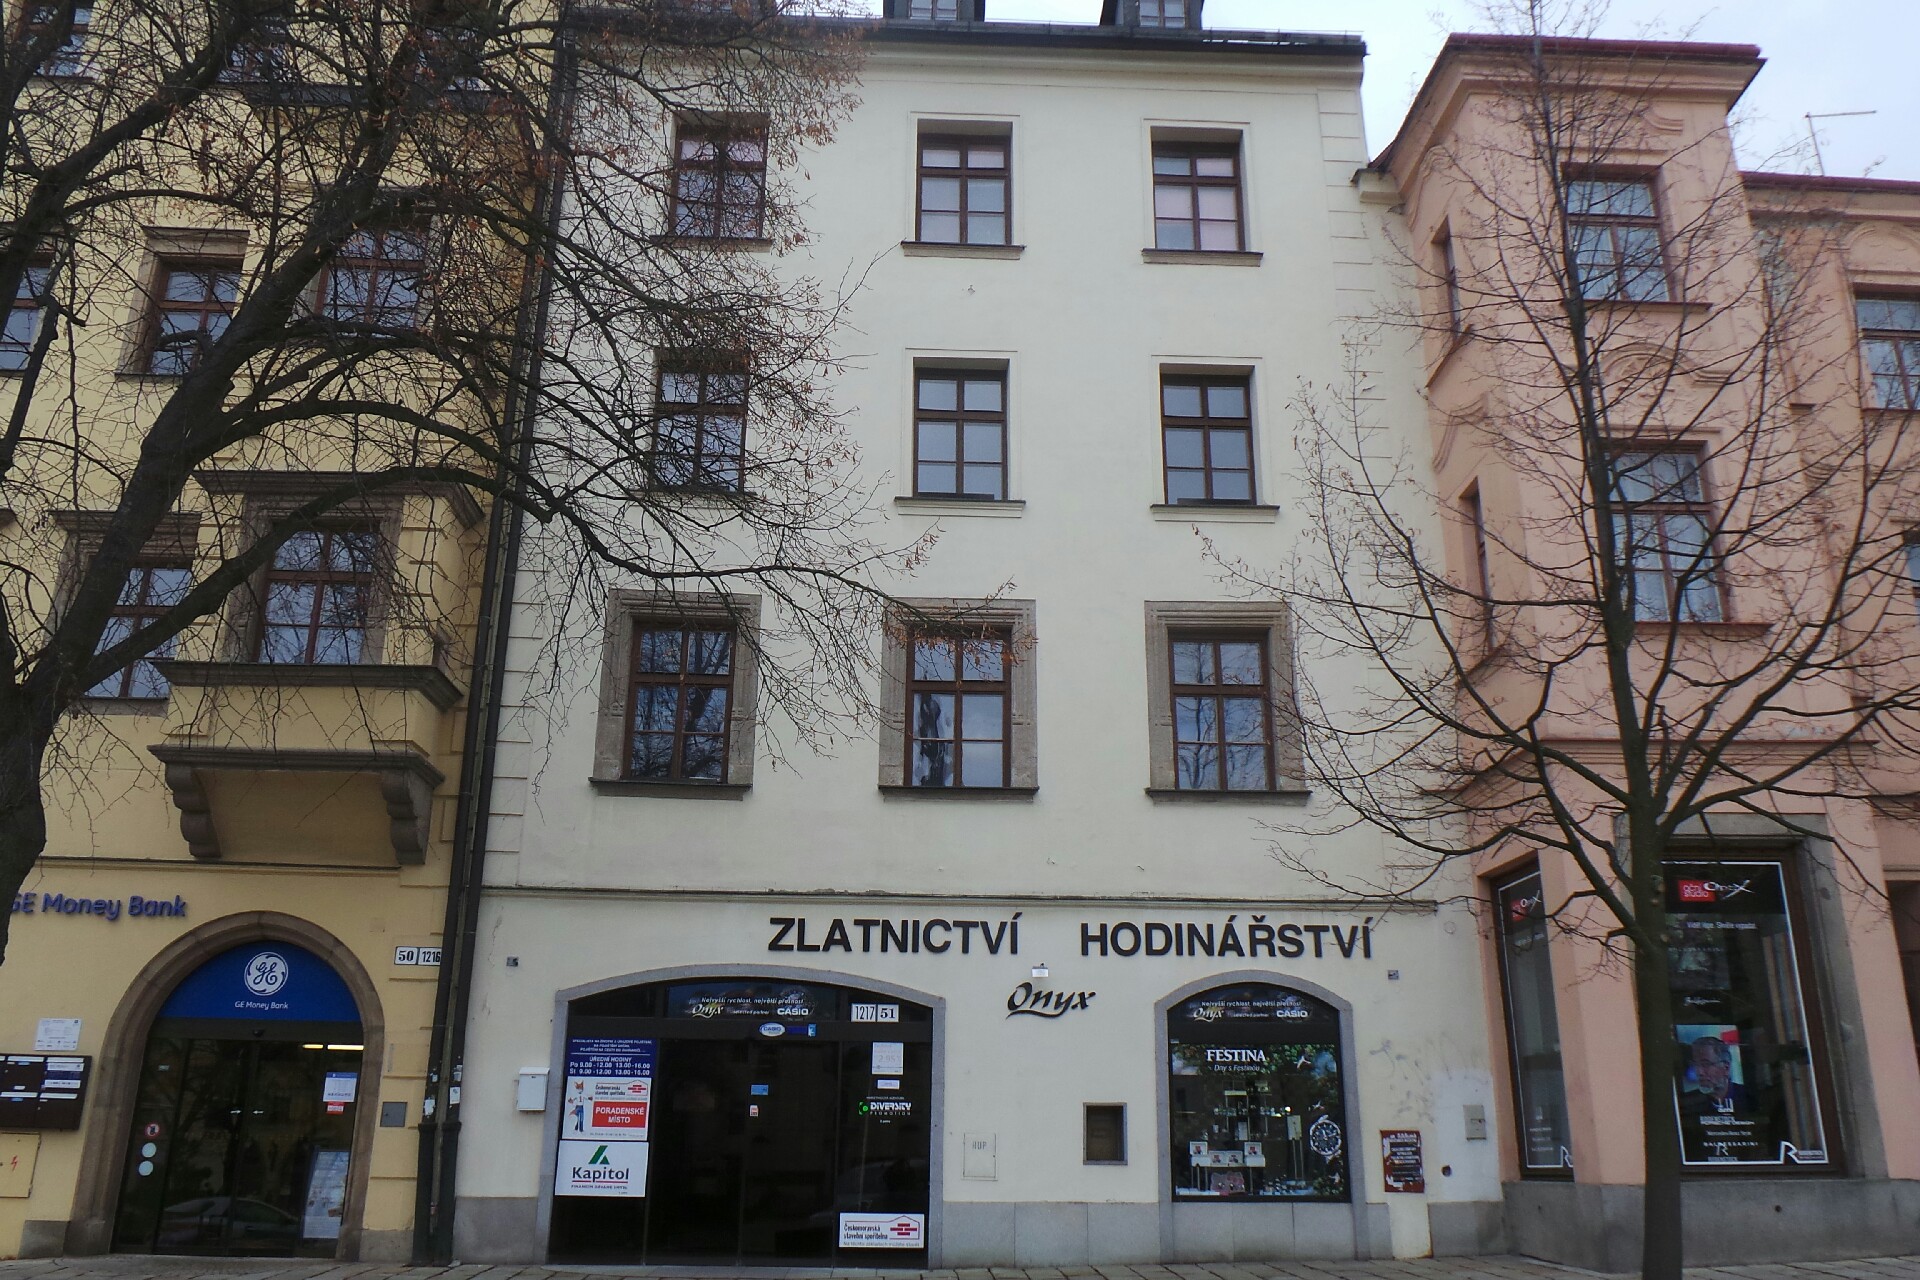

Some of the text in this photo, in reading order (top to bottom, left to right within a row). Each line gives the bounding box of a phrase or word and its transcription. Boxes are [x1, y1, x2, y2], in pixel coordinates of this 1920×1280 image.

[41, 893, 121, 920] Money
[128, 895, 187, 917] Bank
[768, 912, 1374, 958] ZLATNICTVÍ HODINÁŘSTVÍ
[398, 950, 441, 963] 50 1216
[245, 1001, 269, 1011] Money
[271, 1002, 289, 1010] Bank
[1006, 982, 1096, 1020] Onyx
[692, 1004, 724, 1019] Onyx
[777, 1008, 809, 1016] CASIO
[856, 1006, 895, 1020] 1217 51
[1194, 1008, 1225, 1022] Onyx
[1276, 1010, 1308, 1018] CASIO
[1206, 1049, 1267, 1062] FESTINA
[595, 1106, 644, 1115] PORADENSKÉ
[608, 1115, 631, 1123] MÍSTO
[572, 1166, 630, 1183] Kapitol
